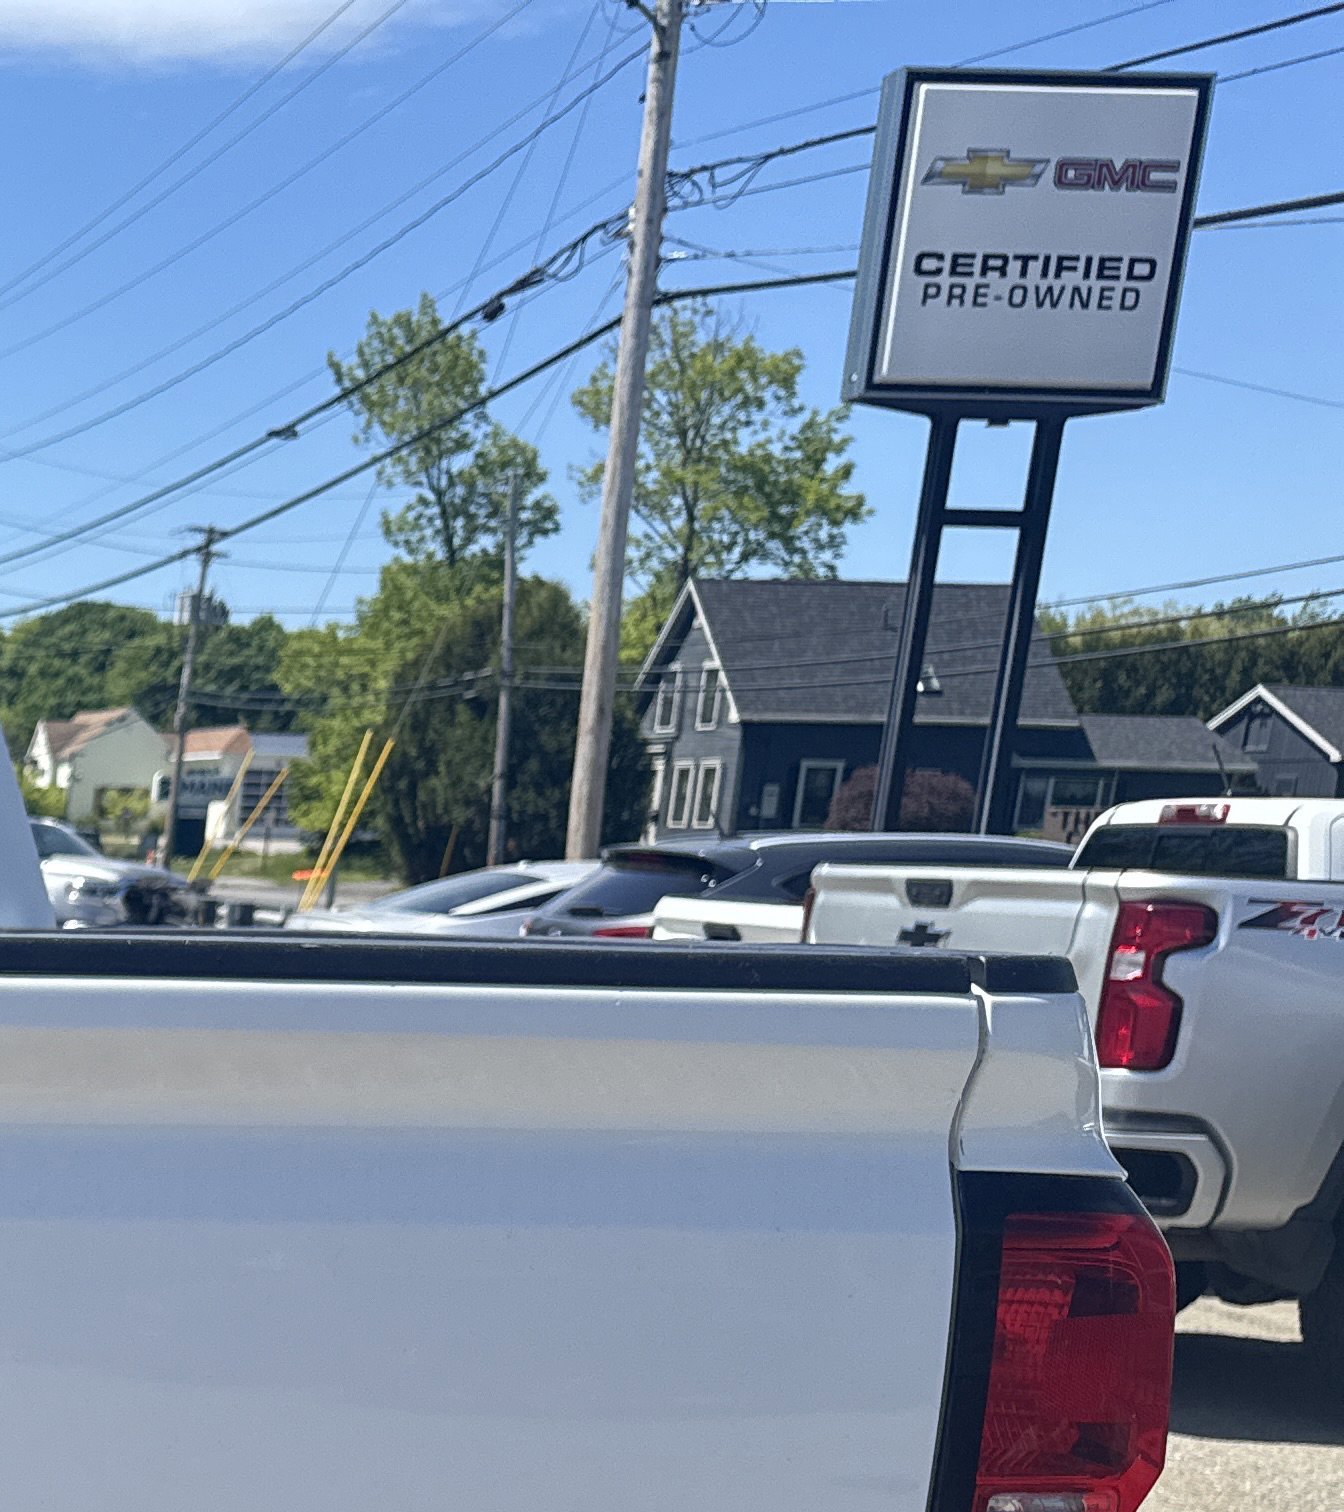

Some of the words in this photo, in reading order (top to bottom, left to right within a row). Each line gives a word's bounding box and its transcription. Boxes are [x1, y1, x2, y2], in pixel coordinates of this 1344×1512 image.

[1053, 157, 1181, 193] GMC
[913, 251, 1158, 282] CERTIFIED
[920, 282, 1142, 311] PRE-OWNED
